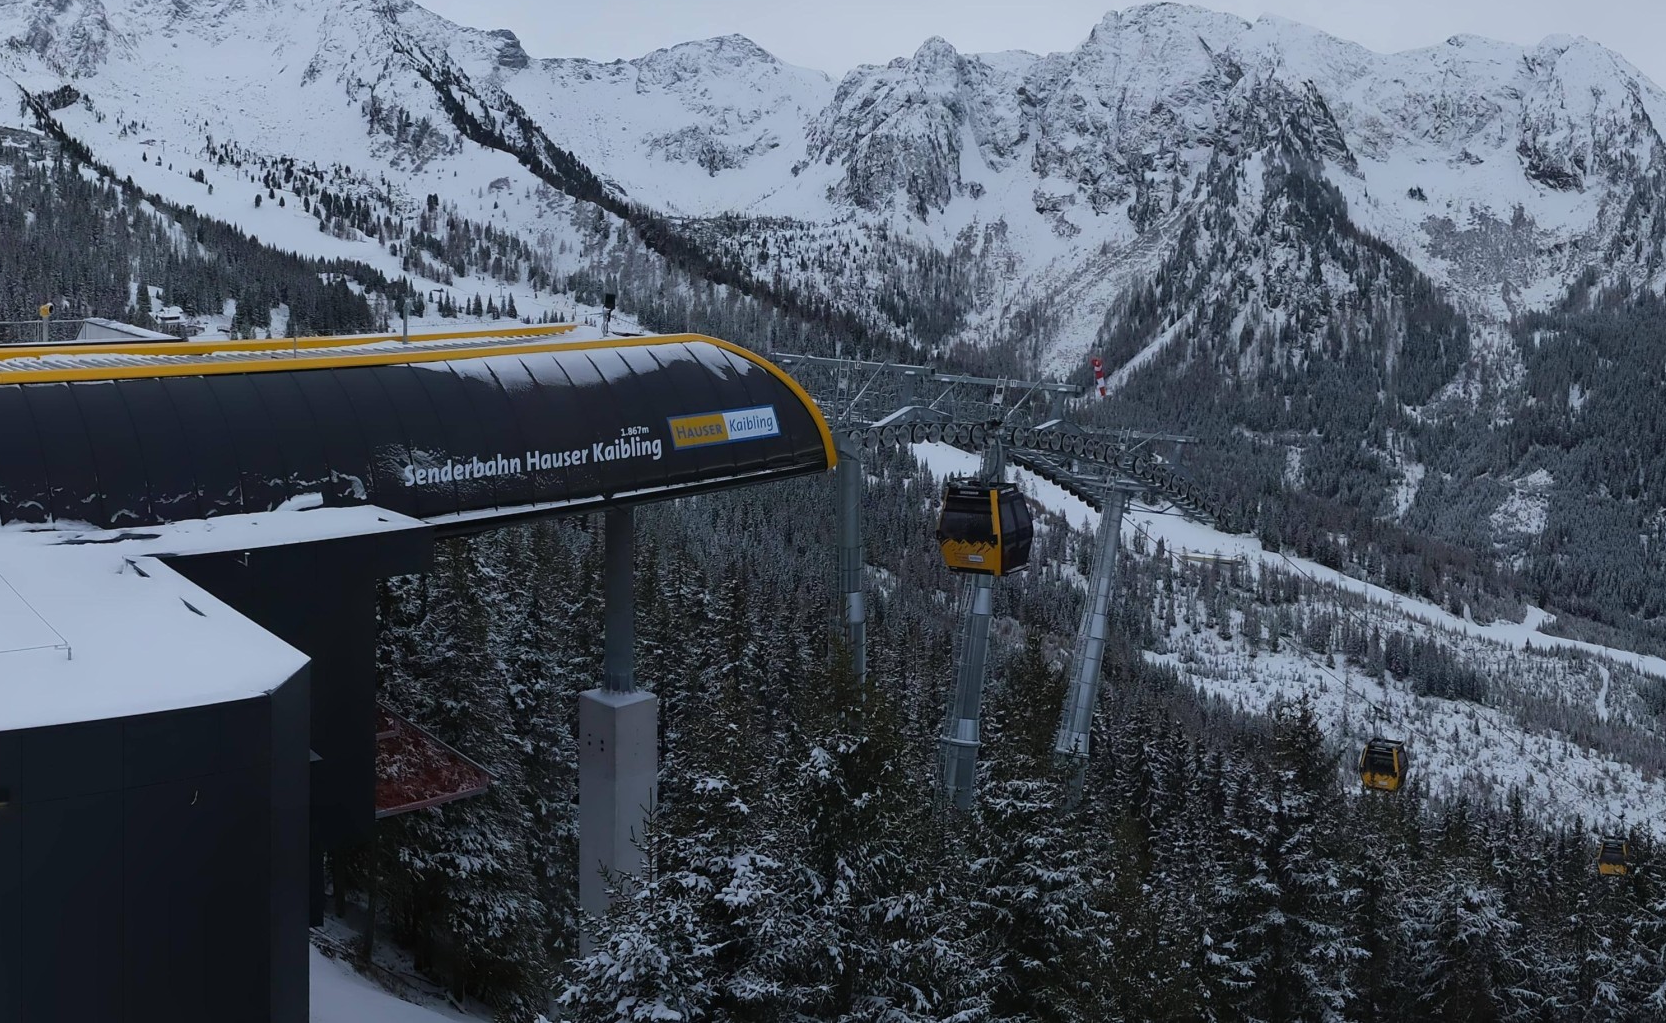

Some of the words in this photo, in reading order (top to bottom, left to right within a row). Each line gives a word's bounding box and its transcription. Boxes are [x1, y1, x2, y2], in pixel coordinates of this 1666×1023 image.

[620, 426, 650, 437] 1.867m
[676, 423, 723, 440] HAUSER
[729, 415, 773, 433] Kaibling
[404, 454, 521, 487] Senderbahn
[526, 448, 589, 471] Hauser
[593, 437, 662, 463] Kaibling
